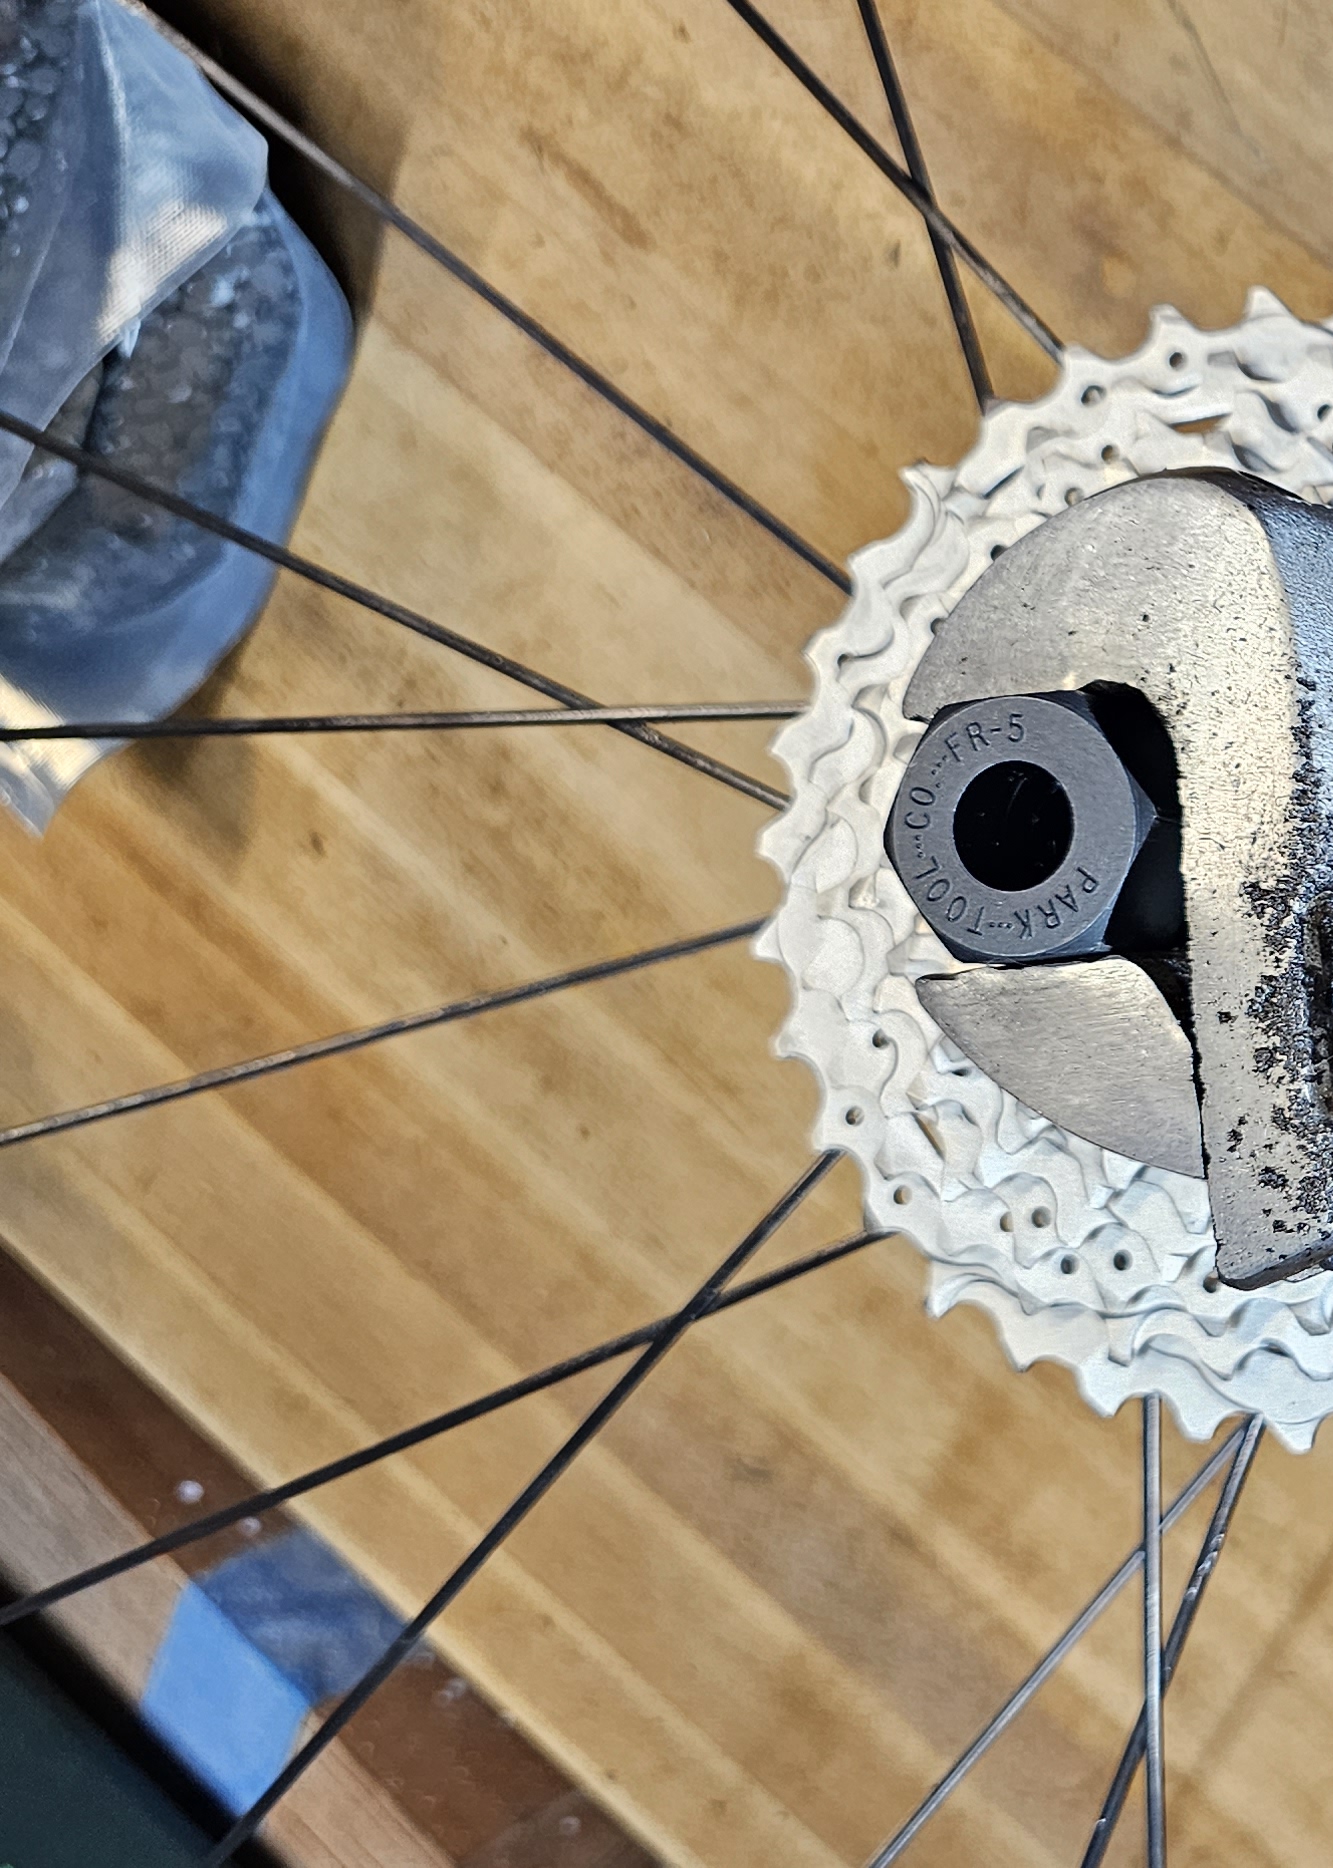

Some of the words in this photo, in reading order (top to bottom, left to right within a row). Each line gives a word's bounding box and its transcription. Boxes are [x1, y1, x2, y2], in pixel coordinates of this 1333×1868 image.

[944, 712, 1026, 763] FR-5
[912, 855, 984, 936] TOOL
[1013, 866, 1099, 940] PARK
